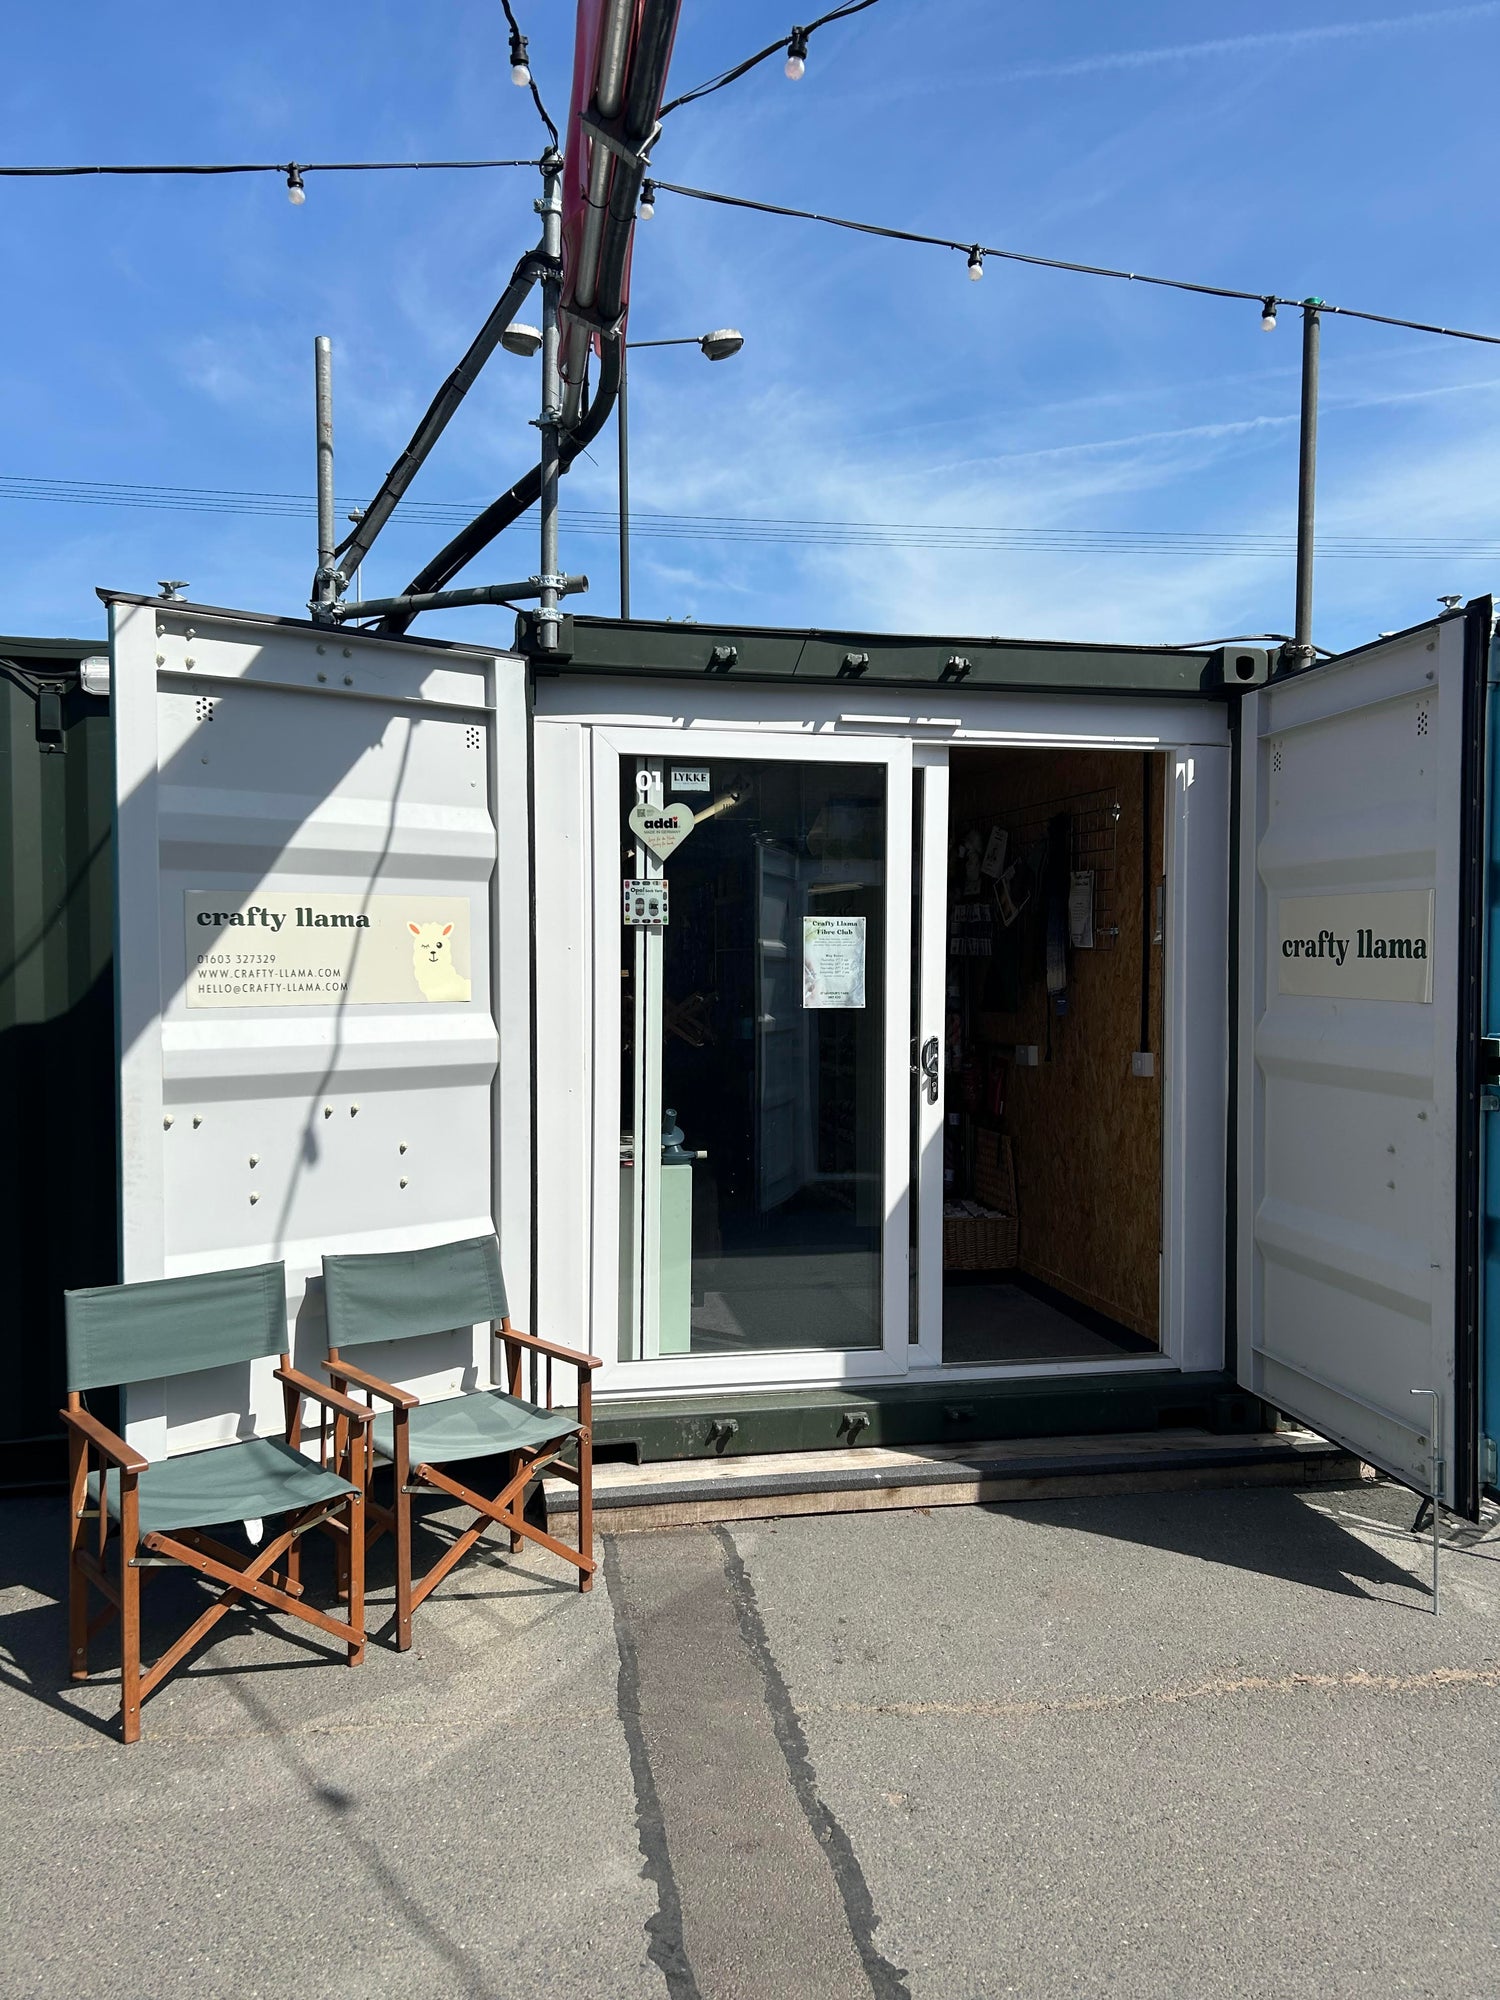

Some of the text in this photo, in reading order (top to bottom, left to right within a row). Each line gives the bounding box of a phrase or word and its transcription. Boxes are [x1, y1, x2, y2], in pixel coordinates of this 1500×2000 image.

[635, 770, 661, 791] 01
[674, 772, 707, 782] LYKKE
[644, 816, 678, 829] addi
[196, 906, 371, 932] crafty llama
[1282, 929, 1428, 966] crafty llama
[197, 954, 277, 965] 01603 327329
[197, 968, 342, 979] WWW.CRAFTY-LLAMA.COM
[197, 982, 349, 994] HELLO@CRAFTY-LLAMA.COM
